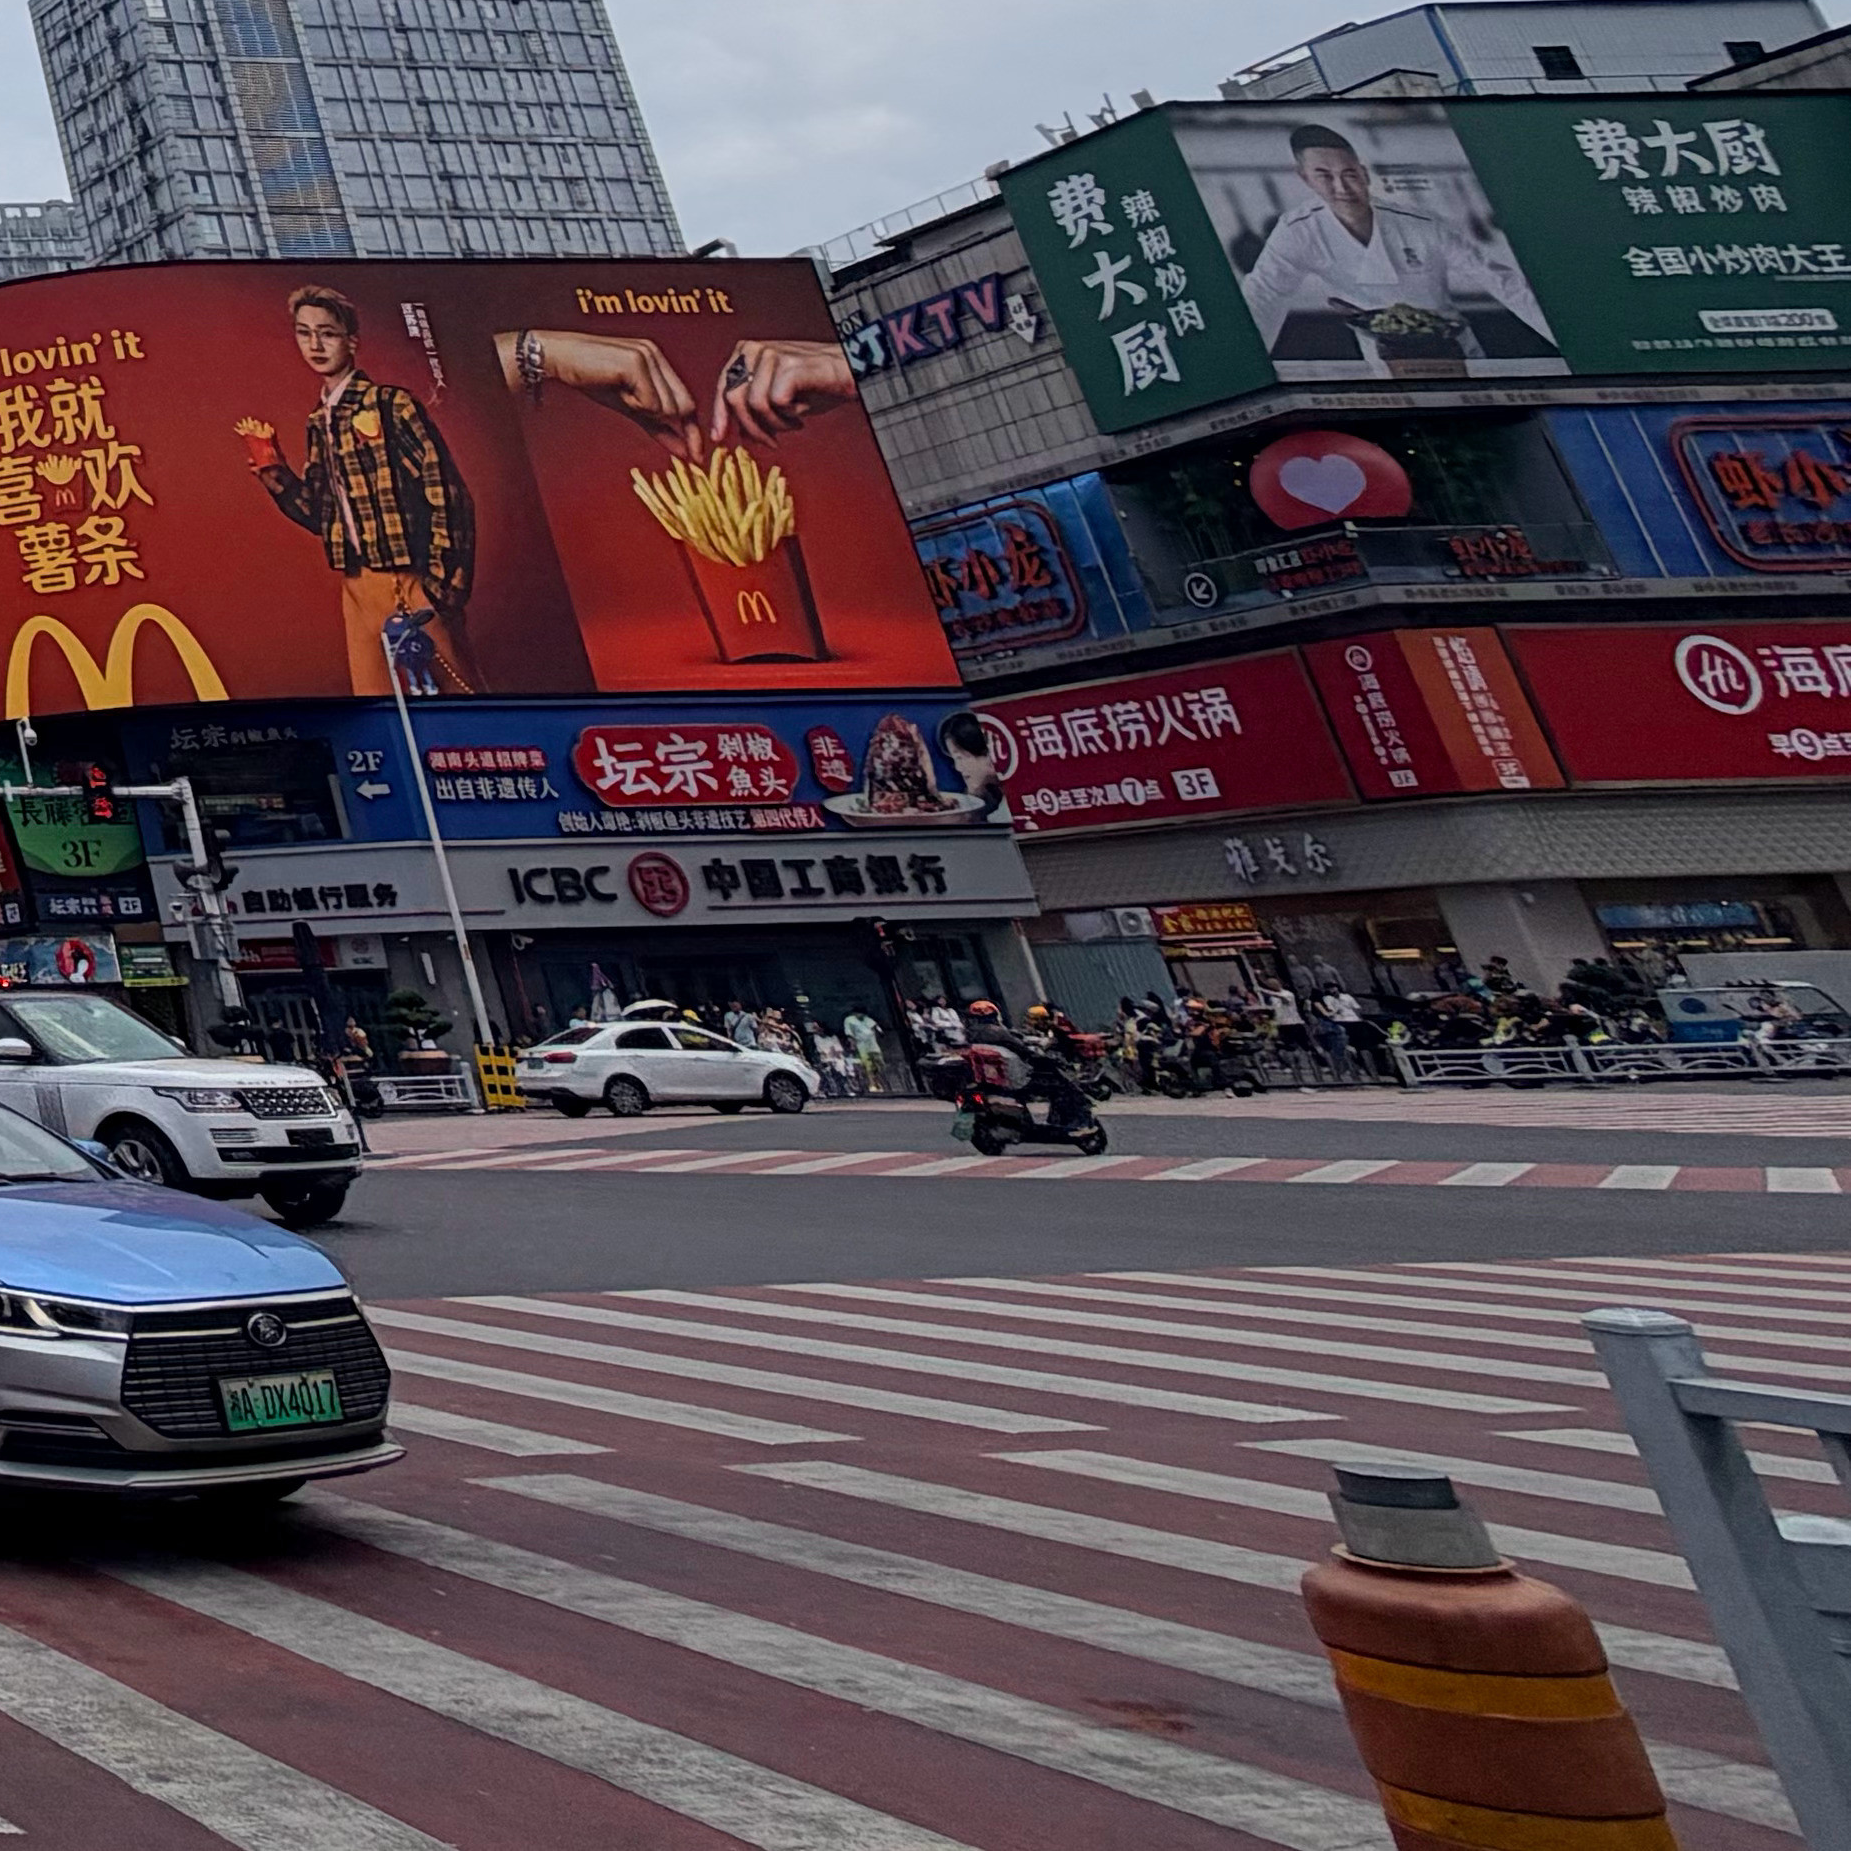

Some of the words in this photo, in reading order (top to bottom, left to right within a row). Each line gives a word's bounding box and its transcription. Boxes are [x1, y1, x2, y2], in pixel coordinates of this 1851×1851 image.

[1571, 116, 1782, 182] 费大厨
[1620, 183, 1789, 217] 辣椒炒肉
[1121, 188, 1206, 338] 辣椒炒肉
[1621, 242, 1851, 278] 全国小炒肉大王
[707, 289, 734, 315] it
[1047, 171, 1182, 398] 费大厨
[887, 281, 994, 357] KTV
[110, 328, 144, 361] it
[1712, 425, 1851, 512] 虾小
[13, 514, 145, 595] 薯条
[1698, 650, 1747, 698] Hi
[717, 732, 781, 763] 剁椒
[1015, 686, 1243, 765] 海底捞火锅
[347, 750, 384, 773] 2F
[593, 732, 719, 798] 坛宗
[811, 735, 855, 783] 非遗
[435, 777, 560, 801] 出自非遗传人
[1176, 772, 1213, 798] 3F
[61, 839, 102, 869] 3F
[241, 882, 398, 914] 自助银行服务
[507, 864, 620, 906] ICBC
[700, 852, 948, 902] 中国工商银行
